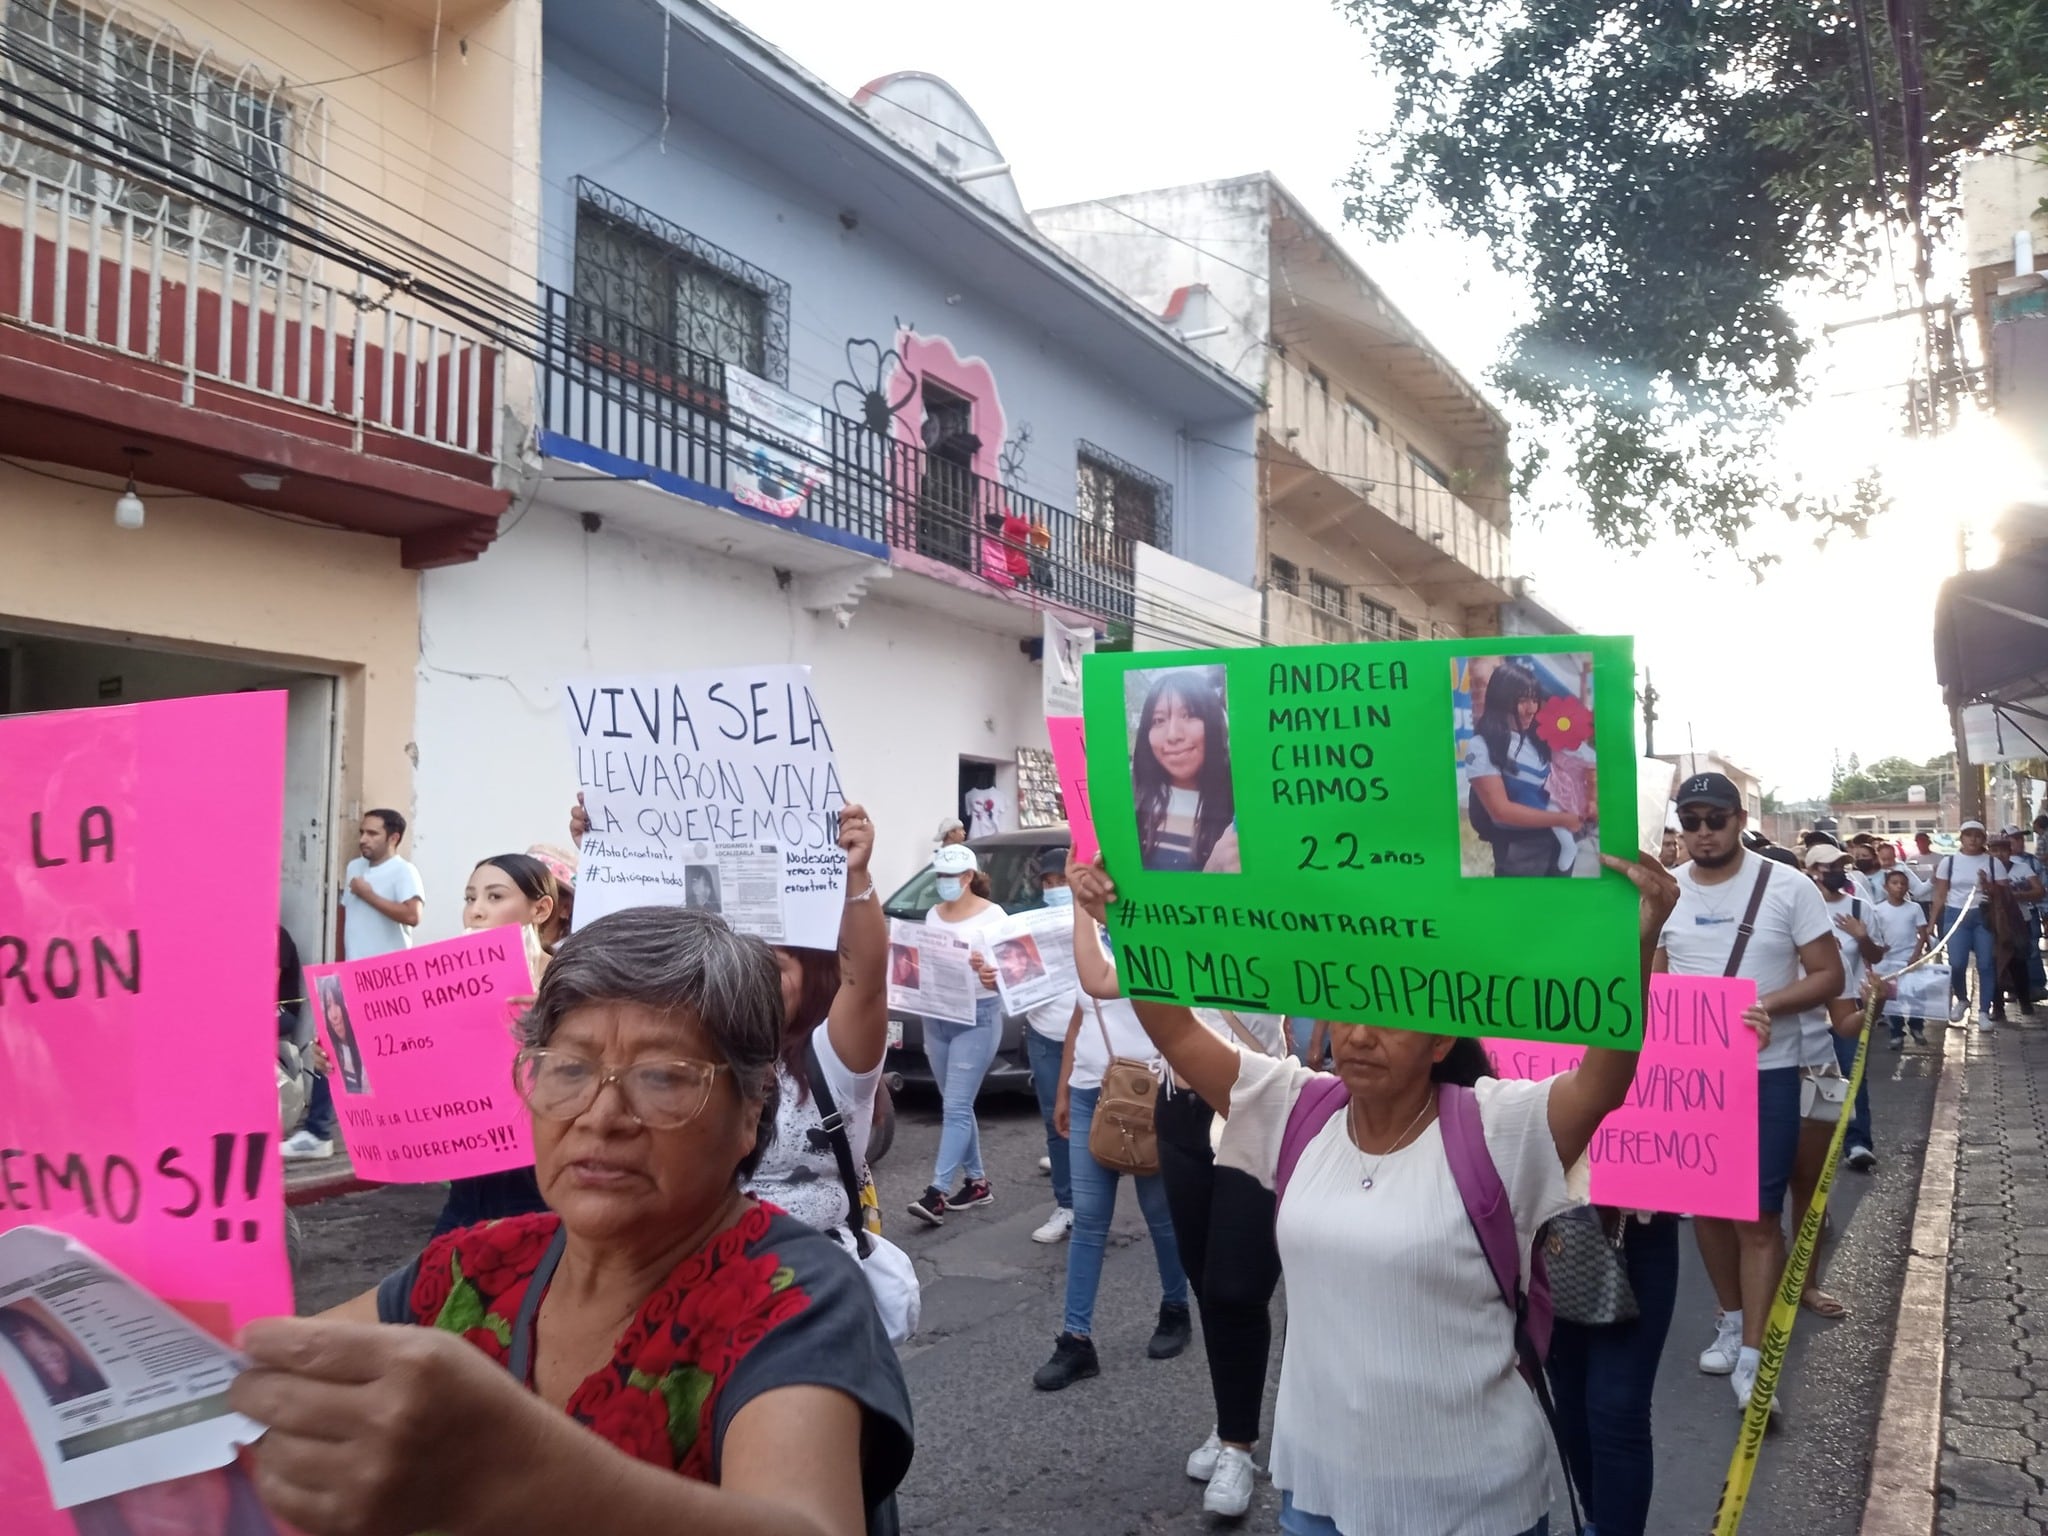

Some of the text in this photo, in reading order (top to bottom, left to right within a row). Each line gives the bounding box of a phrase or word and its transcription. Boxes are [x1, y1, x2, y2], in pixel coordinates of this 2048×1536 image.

[1267, 660, 1409, 696] ANDREA
[566, 681, 834, 752] VIVA SE LA
[1268, 704, 1392, 733] MAYLIN
[1272, 743, 1374, 771] CHINO
[577, 746, 846, 811] LLEVARON VIVA
[1272, 776, 1390, 806] RAMOS
[30, 805, 116, 869] LA
[583, 804, 623, 833] LA
[1296, 832, 1426, 872] 22 años
[1115, 898, 1441, 940] #HASTAENCONTRARTE
[355, 944, 507, 994] ANDREA MAYLIN
[363, 973, 496, 1022] CHINO RAMOS
[1122, 943, 1176, 993] NO
[1187, 949, 1271, 1001] MAS
[1292, 958, 1634, 1039] DESAPARECIDOS
[373, 1032, 399, 1057] 22
[1624, 1063, 1725, 1113] VARON
[345, 1109, 374, 1128] VIVA
[404, 1096, 494, 1124] LLEVARON
[353, 1144, 382, 1162] VIVA
[401, 1124, 519, 1160] QUEREMOS!!!
